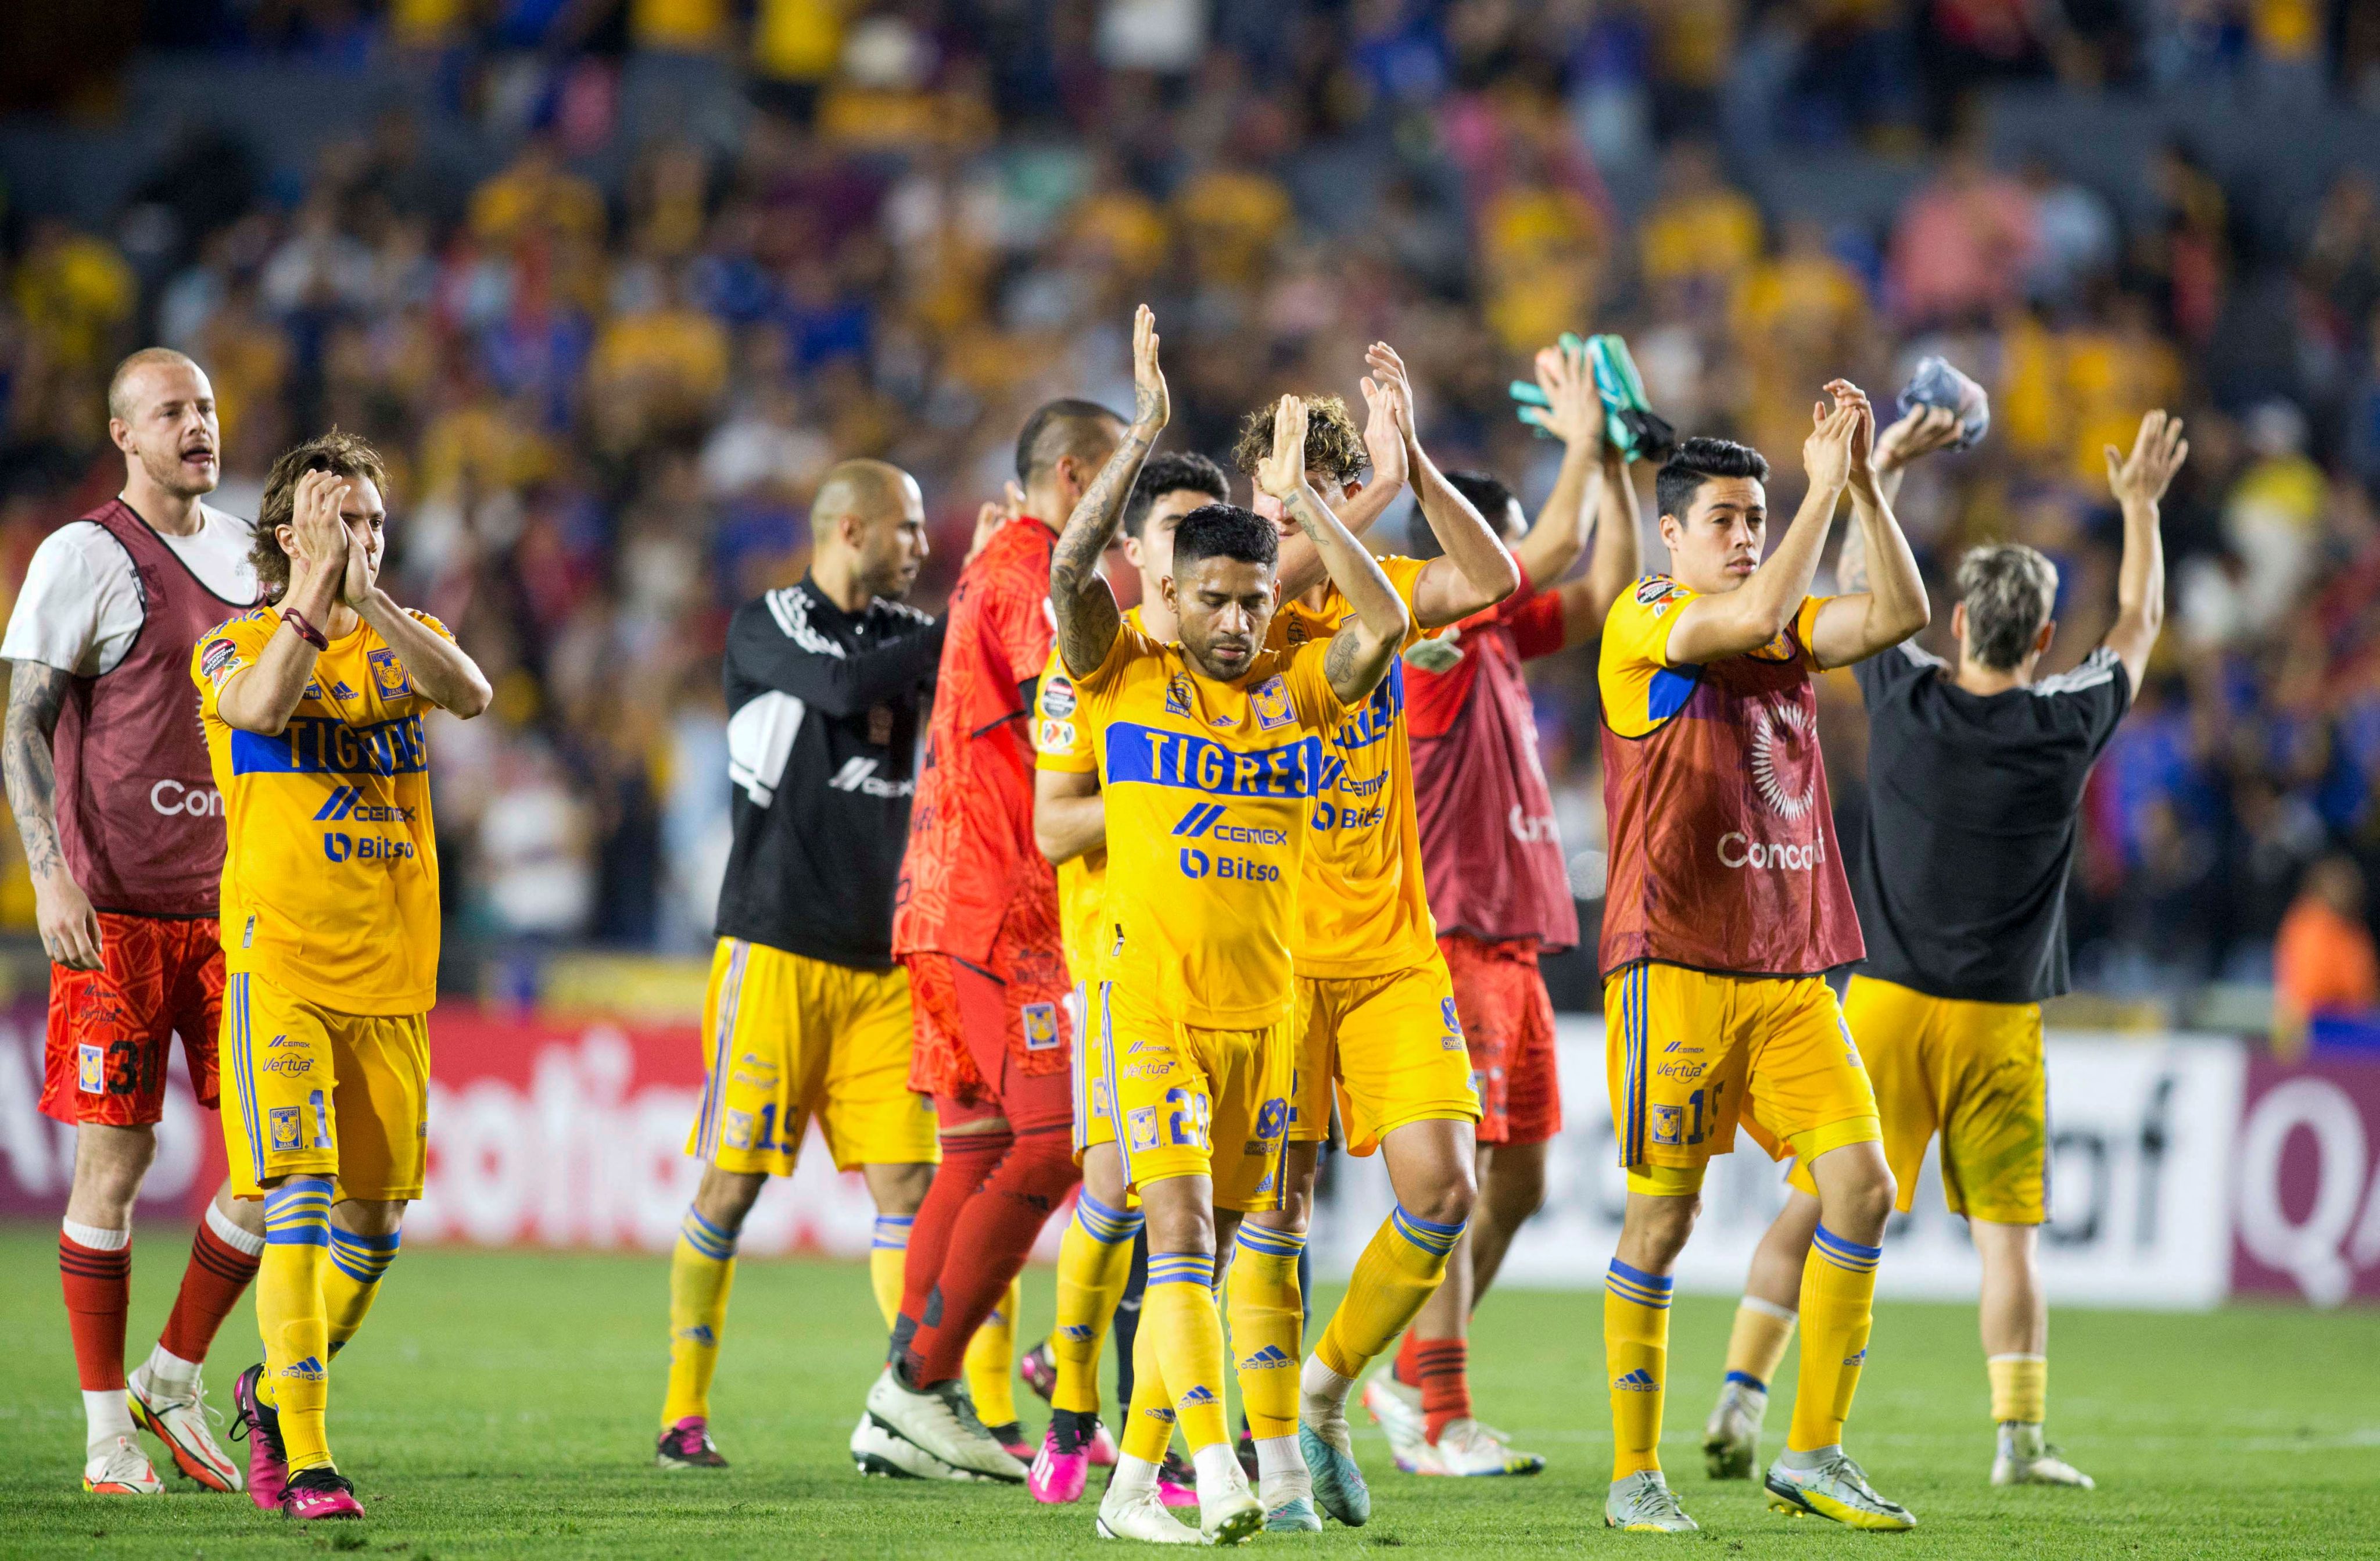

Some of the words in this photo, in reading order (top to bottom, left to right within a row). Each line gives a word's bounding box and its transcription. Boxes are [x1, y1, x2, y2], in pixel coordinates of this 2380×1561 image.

[203, 647, 234, 674] CHAMPIONS
[372, 650, 396, 662] TIGRE
[387, 688, 404, 696] UANL
[1167, 704, 1189, 717] EXTRA
[1145, 731, 1308, 794] TIGRES
[354, 805, 417, 822] CEMEX
[1214, 824, 1287, 846] CEMEX
[357, 835, 414, 859] Bitso
[1216, 856, 1279, 882] Bitso
[108, 1039, 160, 1095] 30
[262, 1057, 311, 1072] Vertua
[1123, 1062, 1169, 1079] Vertua
[1657, 1061, 1702, 1077] Vertua
[273, 1109, 298, 1118] TIGRES
[1241, 1360, 1295, 1369] adidas
